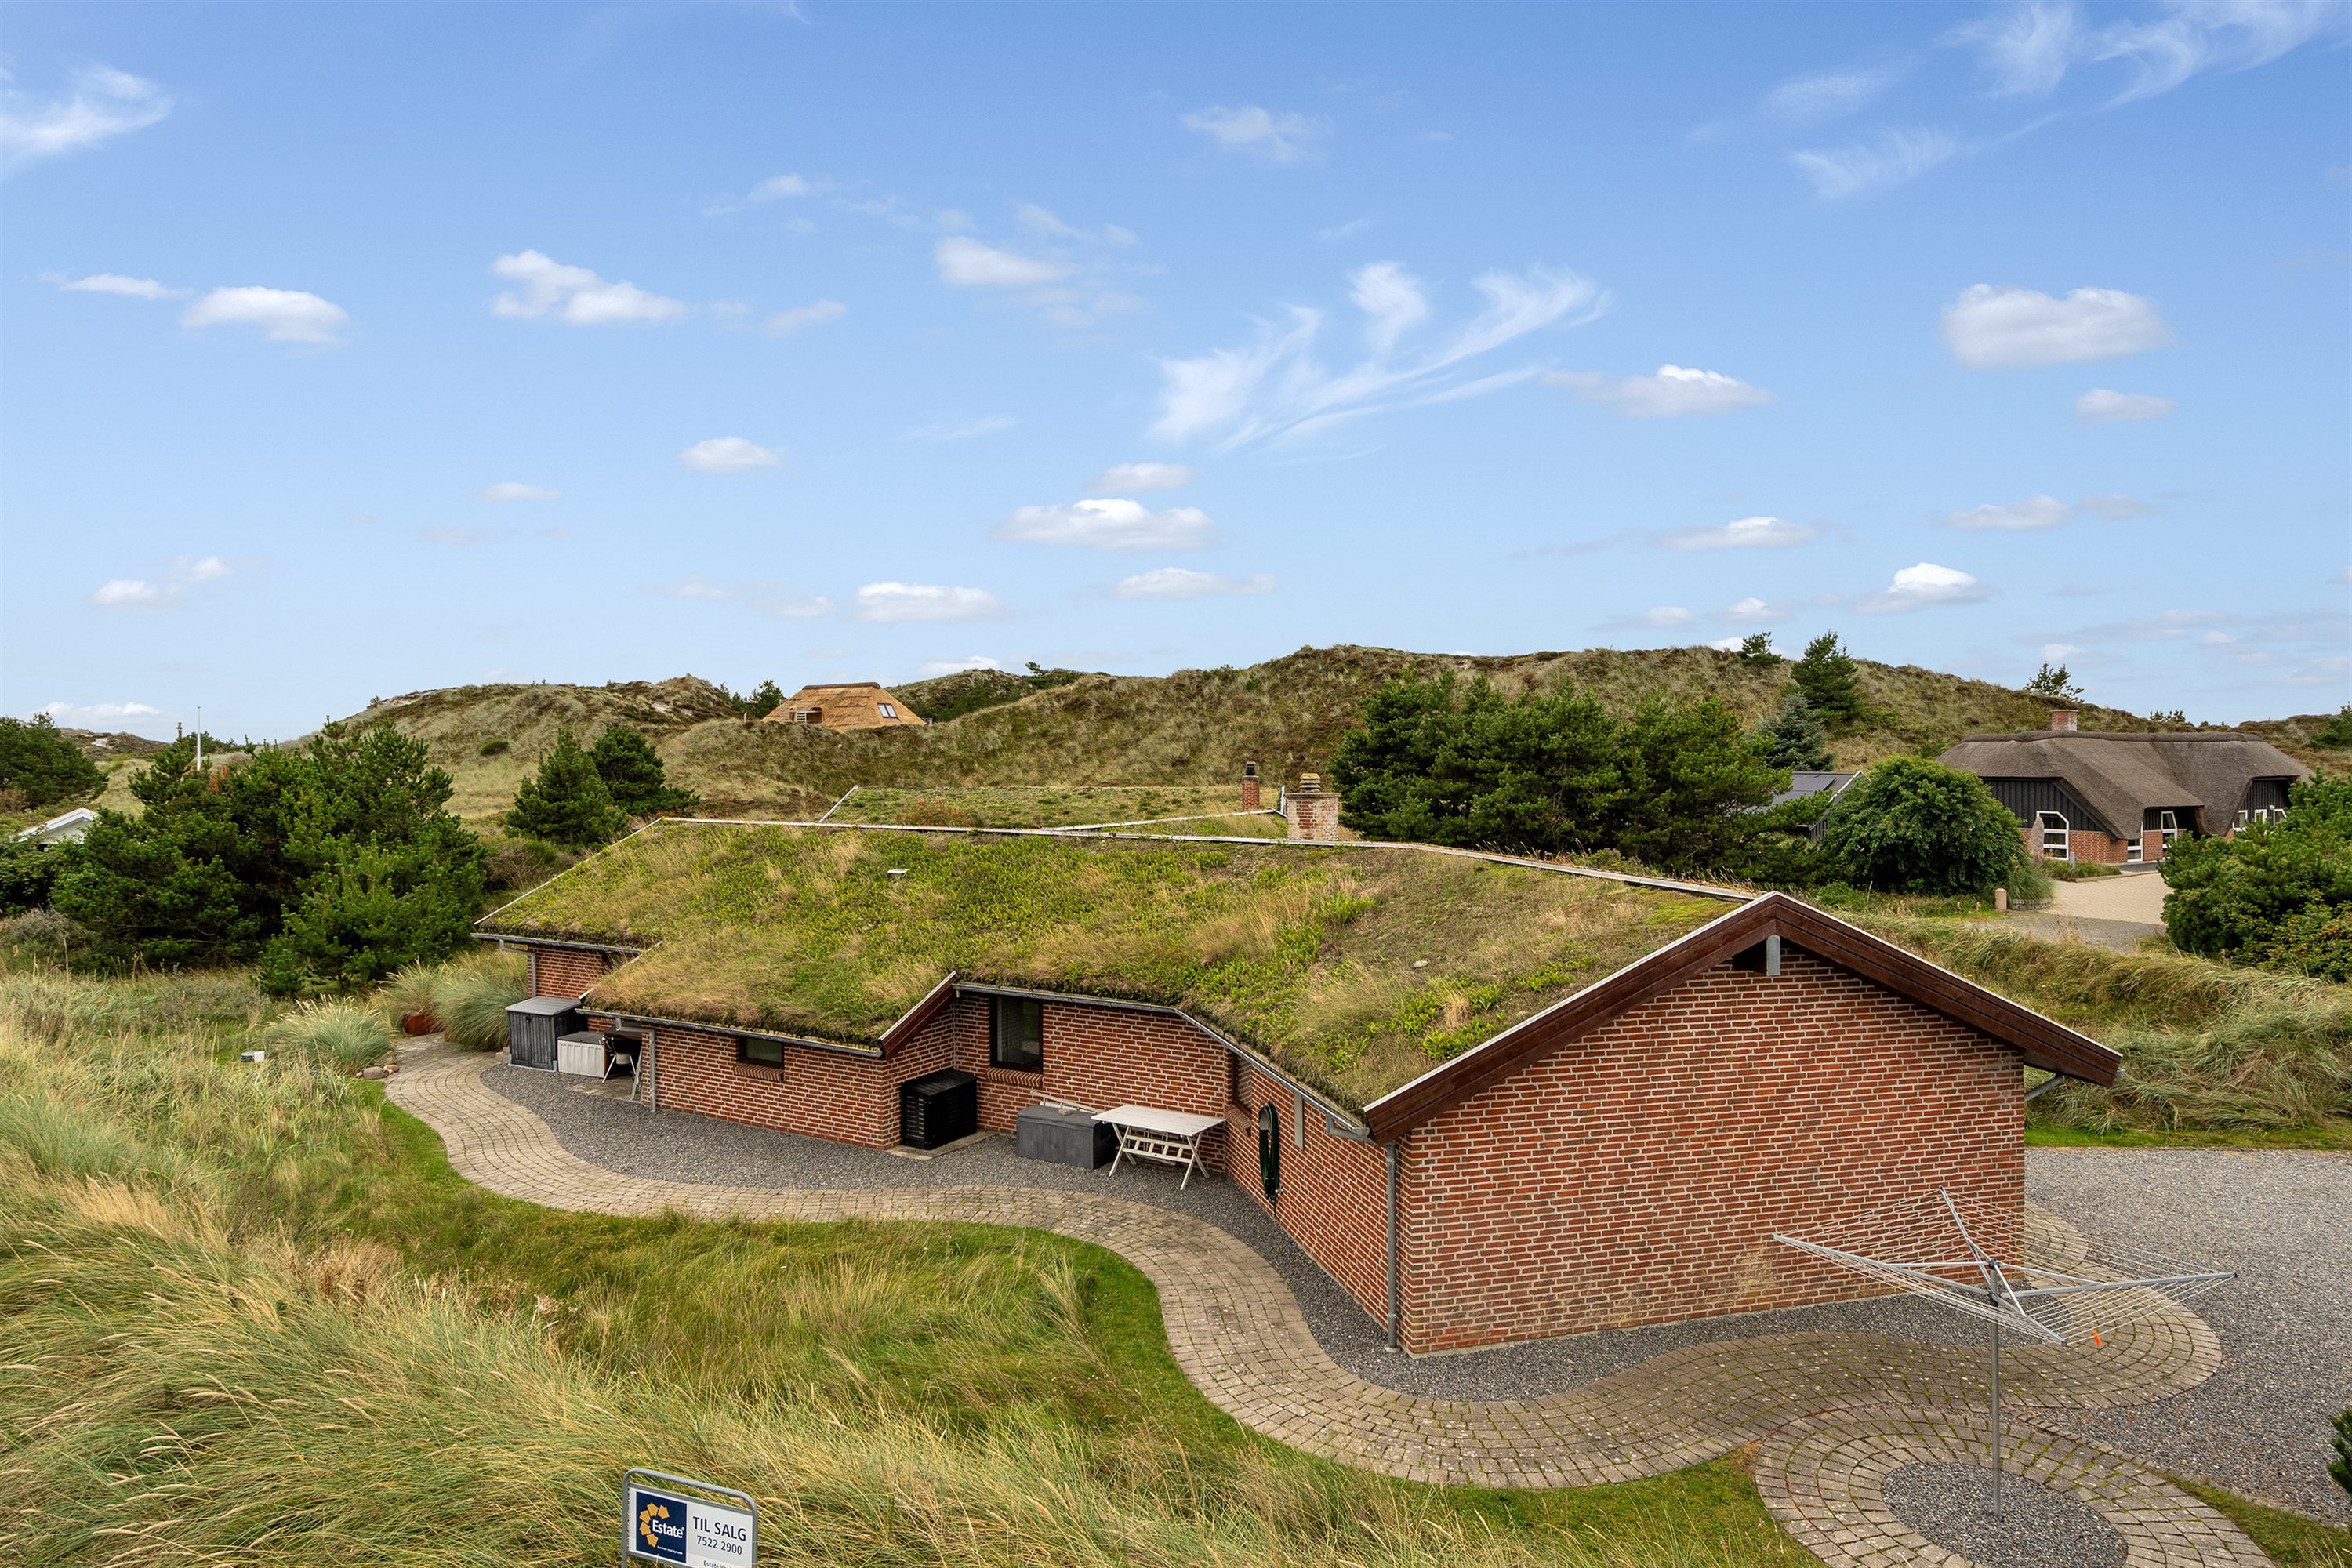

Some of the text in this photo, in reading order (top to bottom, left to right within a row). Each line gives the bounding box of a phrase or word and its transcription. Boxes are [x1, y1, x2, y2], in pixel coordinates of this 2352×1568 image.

[652, 1519, 684, 1539] Estate
[692, 1516, 746, 1542] TIL SALG
[697, 1534, 742, 1555] 7522 2900
